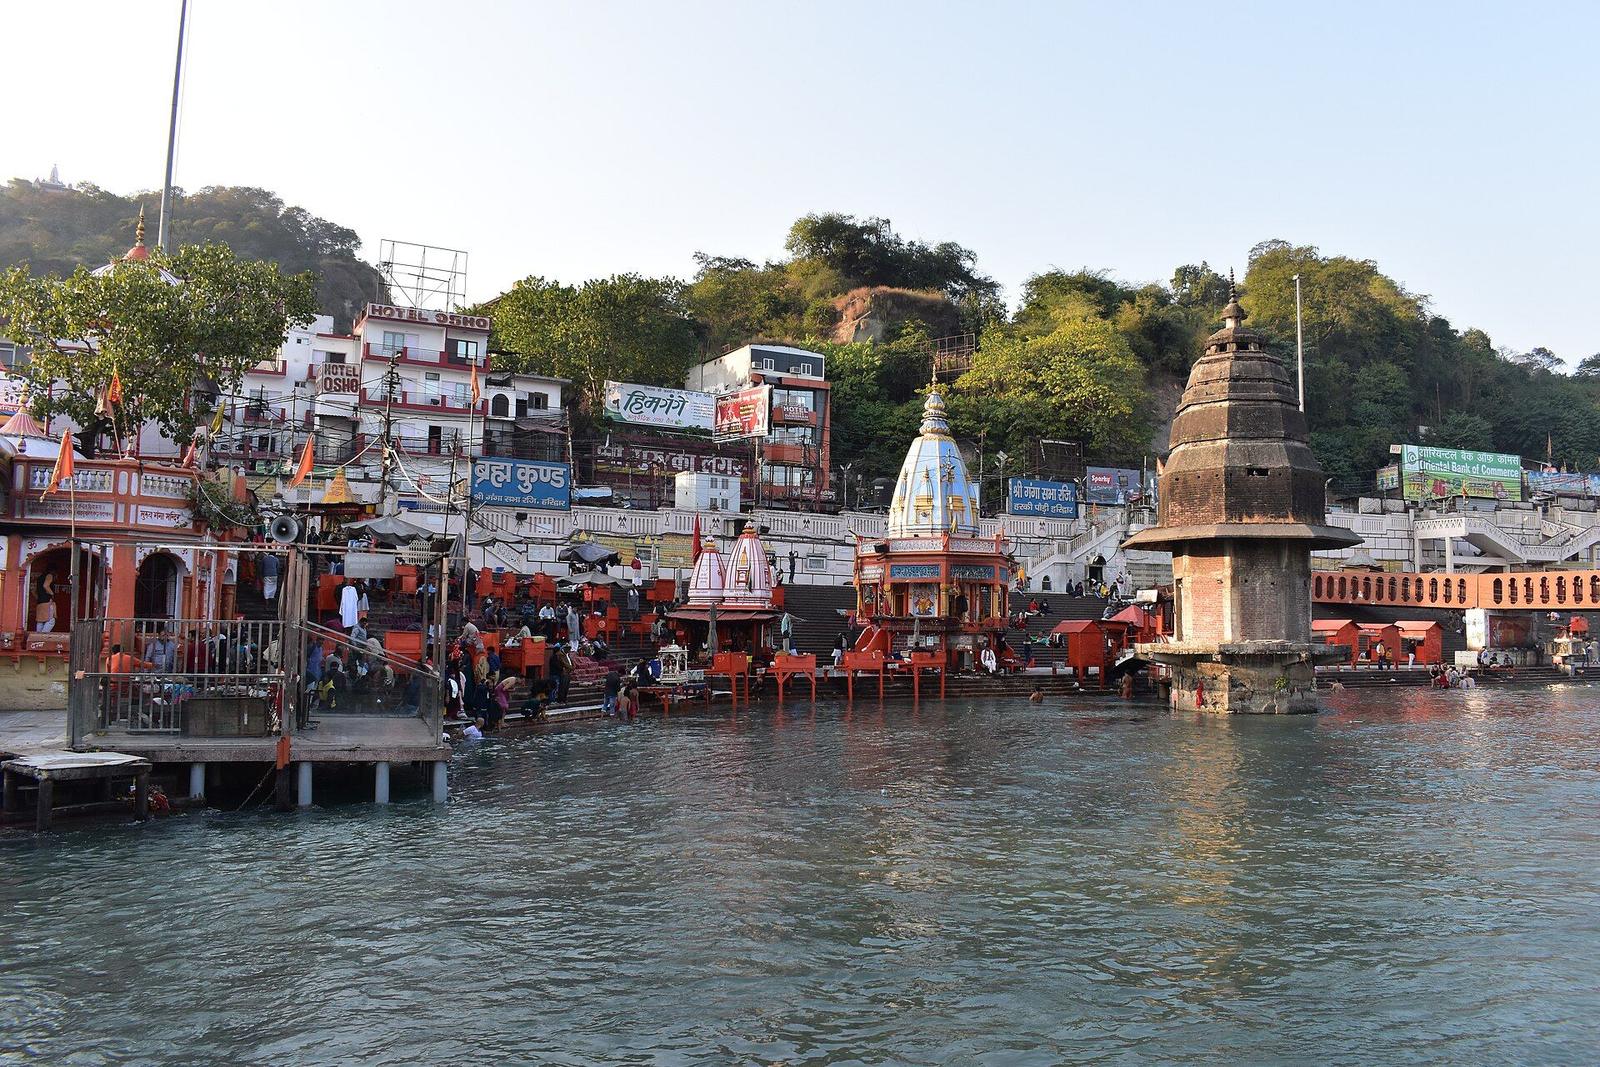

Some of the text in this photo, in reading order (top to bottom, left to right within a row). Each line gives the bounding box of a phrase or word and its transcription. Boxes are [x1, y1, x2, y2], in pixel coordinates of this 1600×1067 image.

[371, 304, 489, 329] HOTEL OSHO
[324, 363, 359, 378] HOTEL
[323, 377, 359, 394] OSHO
[623, 390, 689, 417] हिमगंगे
[783, 405, 809, 414] HOTEL
[474, 461, 567, 494] ब्रह्म कुण्ड
[1419, 460, 1520, 478] Oriental Bank of Commerce
[474, 491, 484, 501] श्री
[504, 495, 520, 504] सभा
[1013, 480, 1023, 498] श्री
[1024, 482, 1040, 499] गंगा
[1042, 487, 1056, 501] सभा
